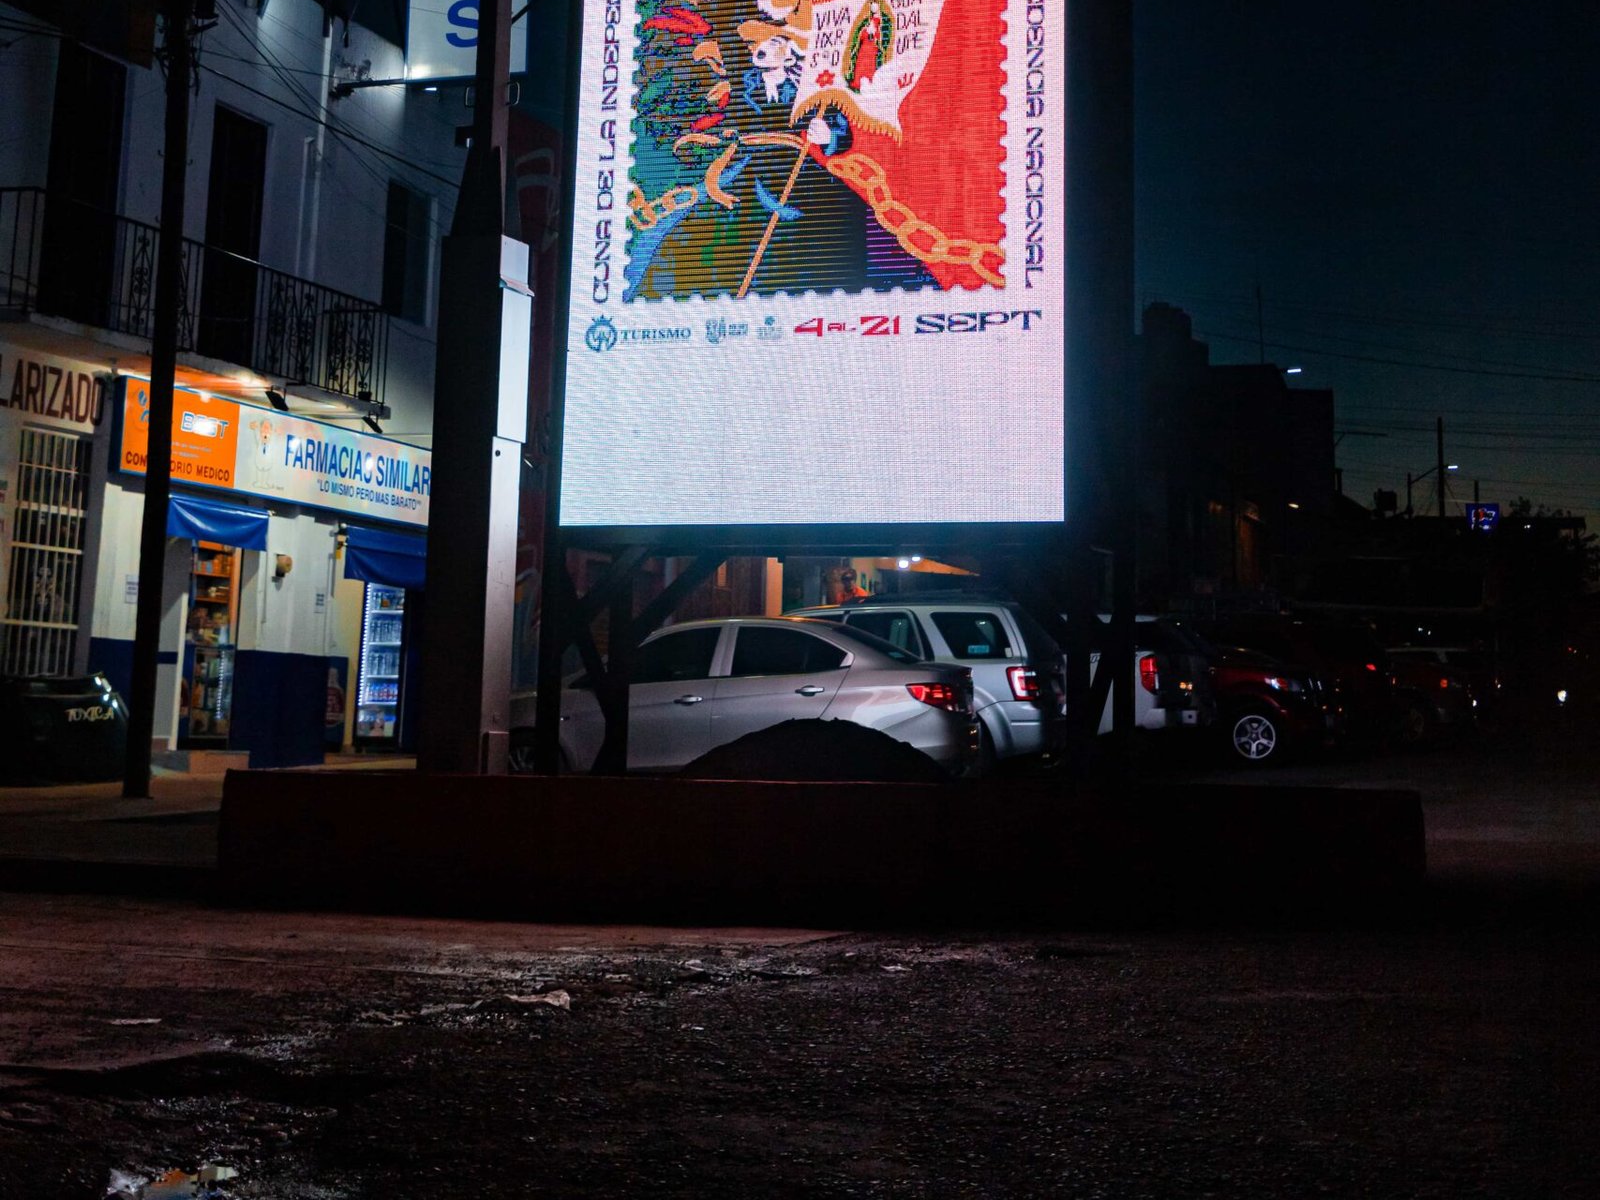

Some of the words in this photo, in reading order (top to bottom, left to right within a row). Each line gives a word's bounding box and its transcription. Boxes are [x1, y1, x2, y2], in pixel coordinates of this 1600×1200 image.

[816, 7, 851, 31] VIVA
[599, 119, 616, 161] LA
[597, 170, 614, 211] DE
[1025, 127, 1044, 289] NACIONAL
[592, 219, 612, 303] CUNA
[621, 328, 692, 341] TURISMO
[793, 317, 824, 337] 4
[827, 321, 857, 332] AL
[860, 315, 901, 336] 21
[915, 309, 1042, 334] SEPT
[125, 451, 192, 475] CONORIO
[196, 464, 230, 482] MEDICO
[285, 434, 373, 484] FARMACIAS
[376, 455, 432, 496] SIMILAR
[331, 482, 354, 498] MISMO
[356, 487, 374, 502] PERO
[375, 491, 389, 505] MAS
